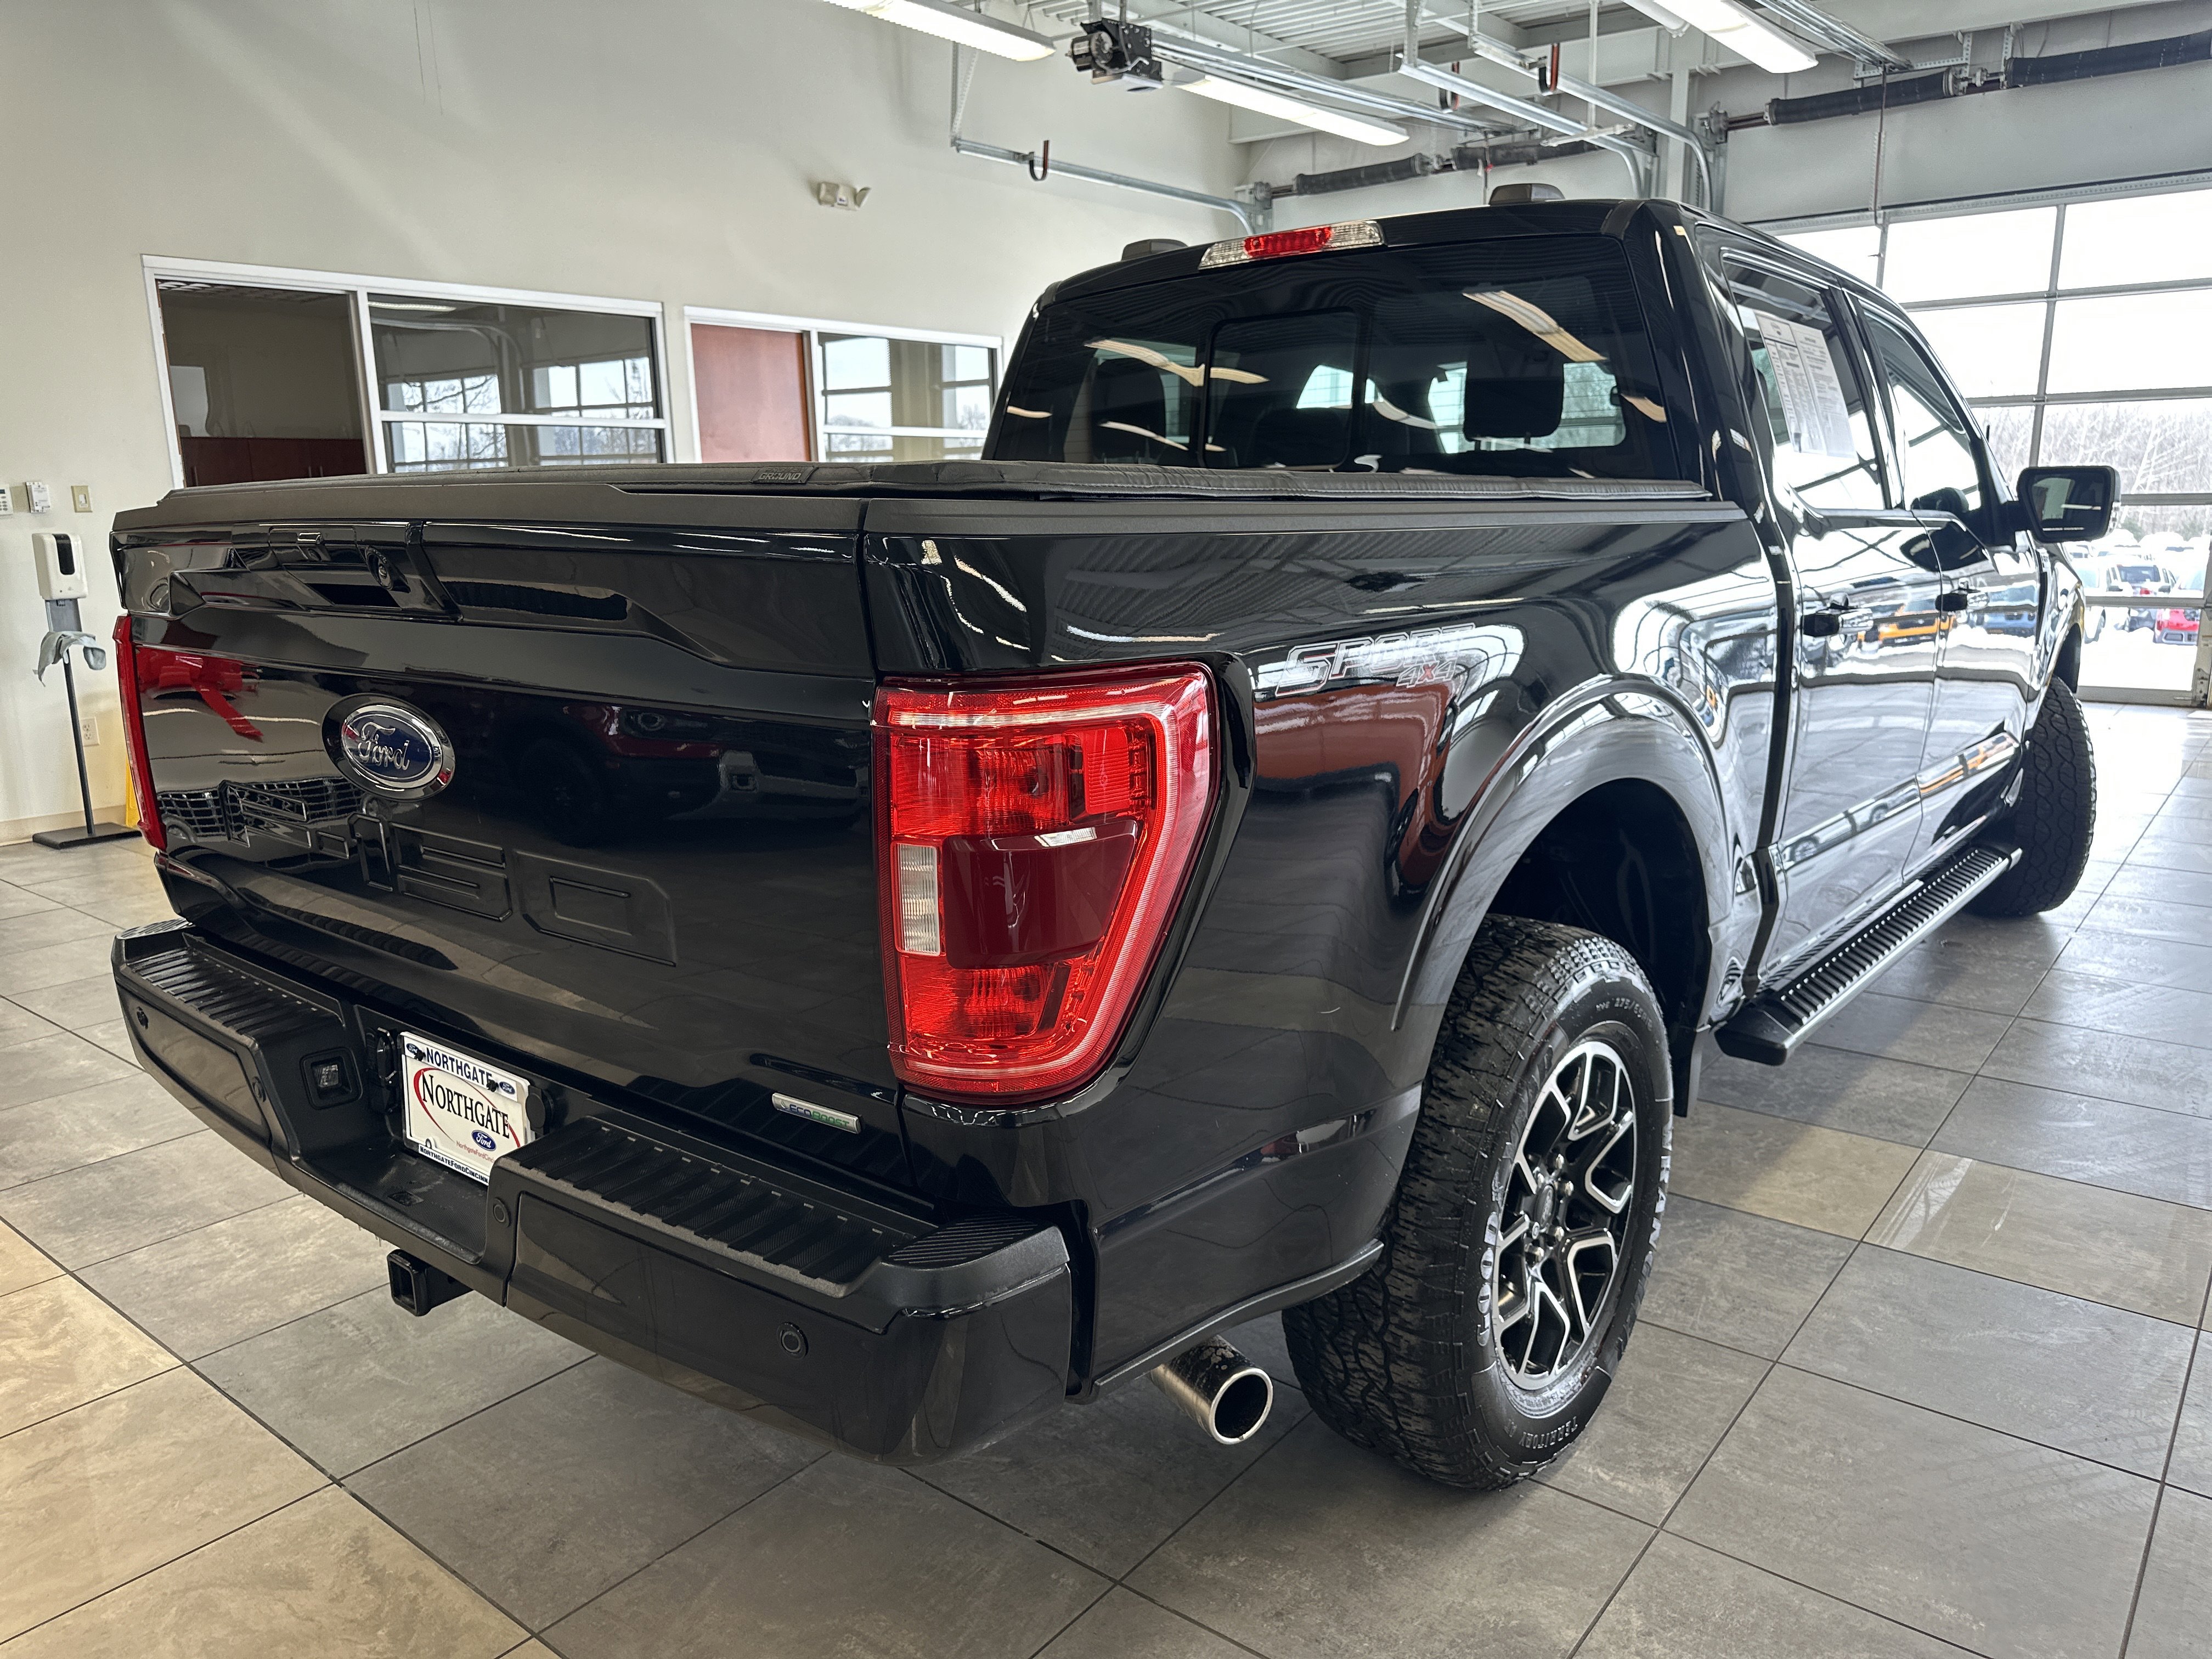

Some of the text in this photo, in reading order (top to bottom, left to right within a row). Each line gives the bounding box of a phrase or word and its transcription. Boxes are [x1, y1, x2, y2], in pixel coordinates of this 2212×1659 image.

[1275, 623, 1476, 696] SPORT
[357, 721, 410, 770] Ford
[219, 778, 677, 967] F-150
[426, 1047, 493, 1088] NORTHGATE
[476, 1132, 492, 1148] Ford
[1518, 1415, 1578, 1449] TERRITORY
